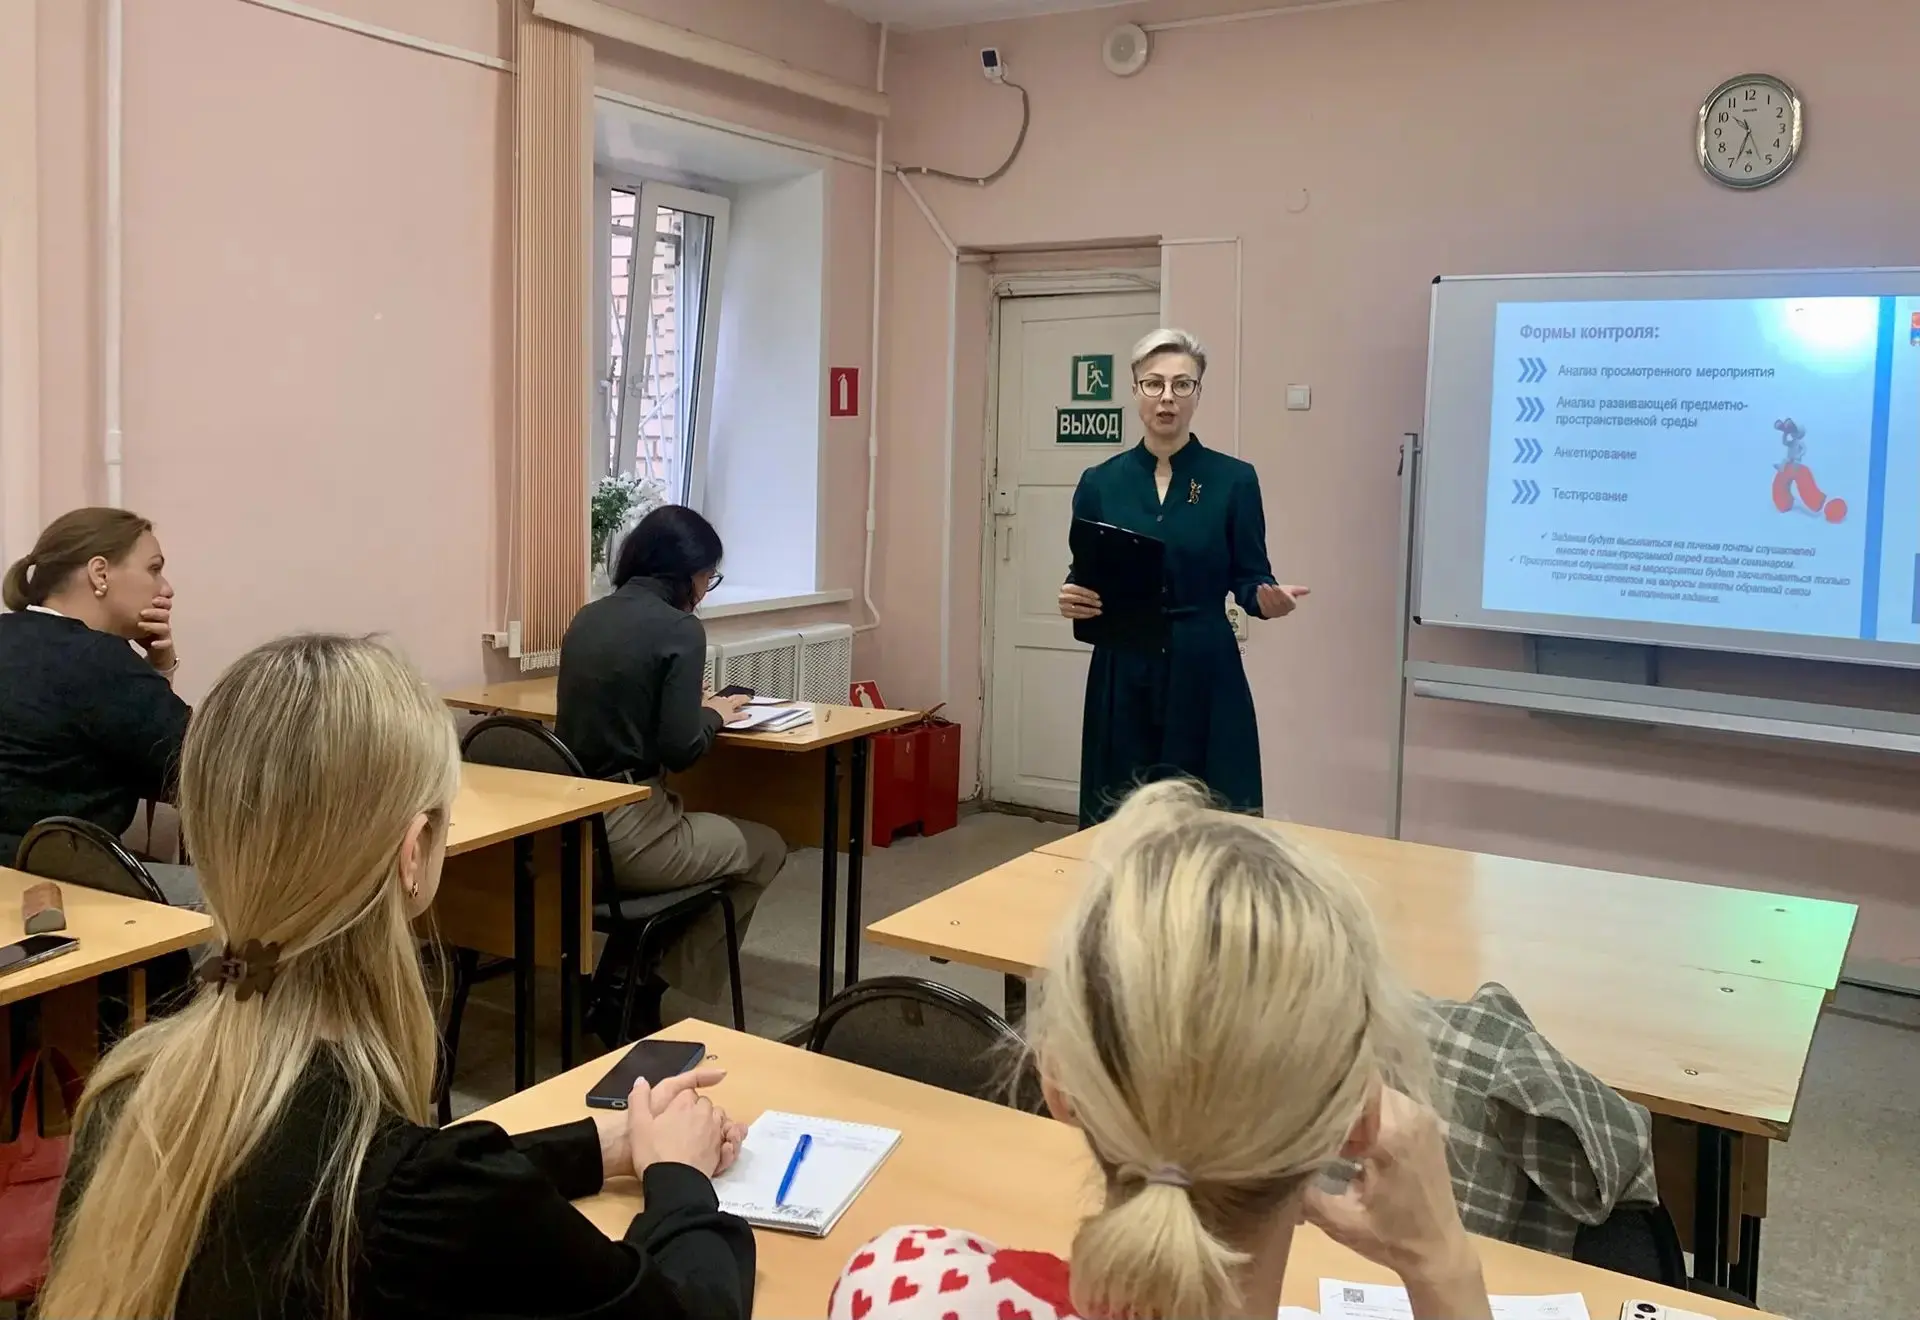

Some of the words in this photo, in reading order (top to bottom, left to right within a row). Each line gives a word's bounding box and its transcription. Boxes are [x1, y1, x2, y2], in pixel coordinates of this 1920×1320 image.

[1745, 89, 1756, 101] 12
[1767, 94, 1771, 105] 1
[1728, 97, 1736, 108] 11
[1718, 112, 1729, 123] 10
[1776, 107, 1783, 118] 2
[1714, 127, 1722, 139] 9
[1779, 123, 1786, 134] 3
[1718, 142, 1726, 153] 8
[1772, 138, 1780, 149] 4
[1728, 158, 1735, 168] 7
[1765, 154, 1772, 165] 5
[1744, 162, 1752, 173] 6
[1519, 324, 1576, 342] Формы
[1580, 325, 1660, 342] контроля:
[1558, 364, 1597, 377] Анализ
[1601, 366, 1691, 379] просмотренного
[1696, 368, 1775, 380] мероприятия
[1556, 396, 1595, 409] Анализ
[1599, 397, 1677, 412] развивающей
[1680, 400, 1748, 413] предметно-
[1060, 413, 1119, 439] ВЫХОД
[1555, 414, 1657, 428] пространственной
[1661, 417, 1698, 429] среды
[1554, 446, 1637, 461] Анкетирование
[1552, 487, 1628, 503] Тестирование
[1588, 533, 1615, 545] будут
[1674, 541, 1685, 549] на
[1722, 543, 1753, 553] почты
[1674, 553, 1702, 564] перед
[1703, 554, 1740, 565] каждым
[1630, 563, 1641, 571] на
[1705, 566, 1734, 578] будет
[1814, 576, 1851, 586] только
[1551, 571, 1567, 581] при
[1645, 577, 1656, 585] на
[1658, 578, 1696, 589] вопросы
[1735, 582, 1782, 595] обратной
[1620, 589, 1626, 597] и
